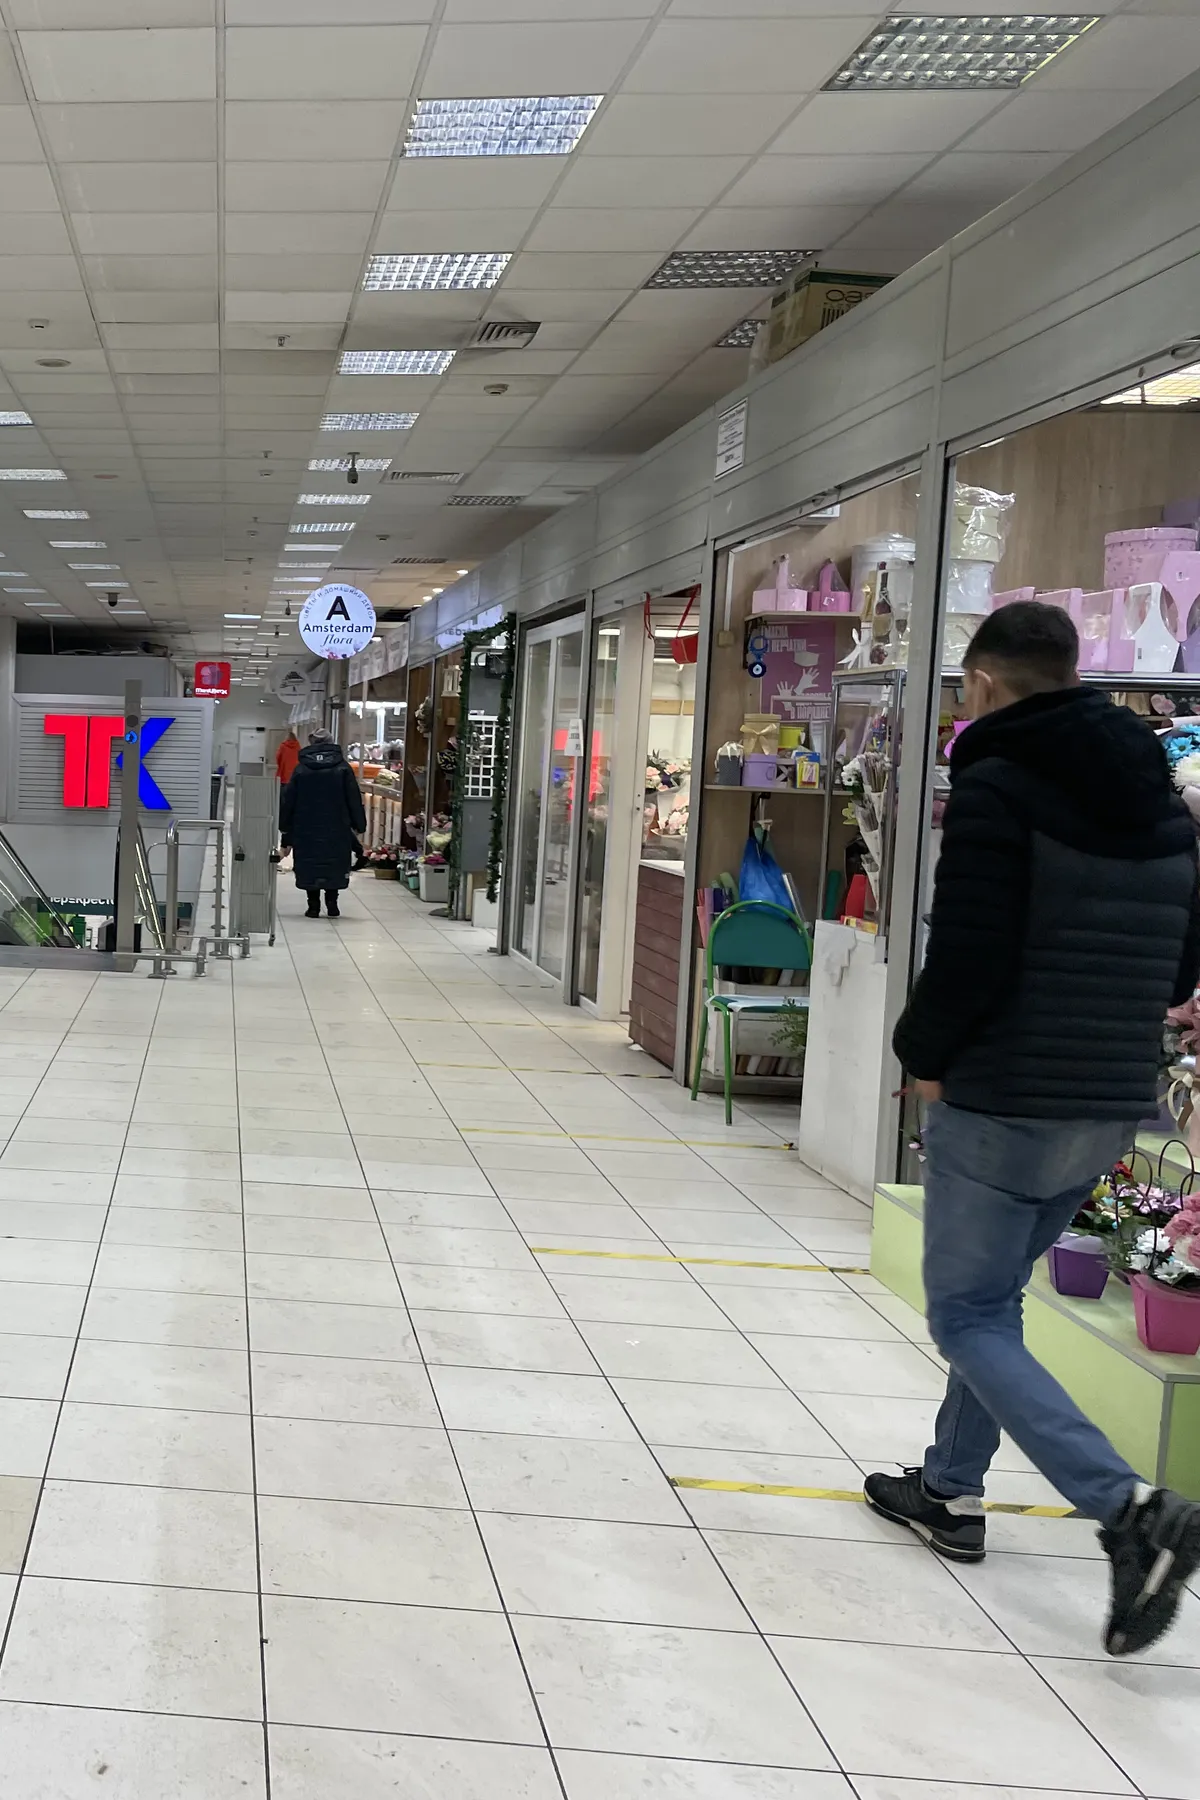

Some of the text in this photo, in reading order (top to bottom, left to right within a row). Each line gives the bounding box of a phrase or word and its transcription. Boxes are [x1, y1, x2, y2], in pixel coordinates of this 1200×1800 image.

[325, 596, 351, 620] A
[303, 623, 373, 633] Amsterdam
[323, 634, 353, 646] flora
